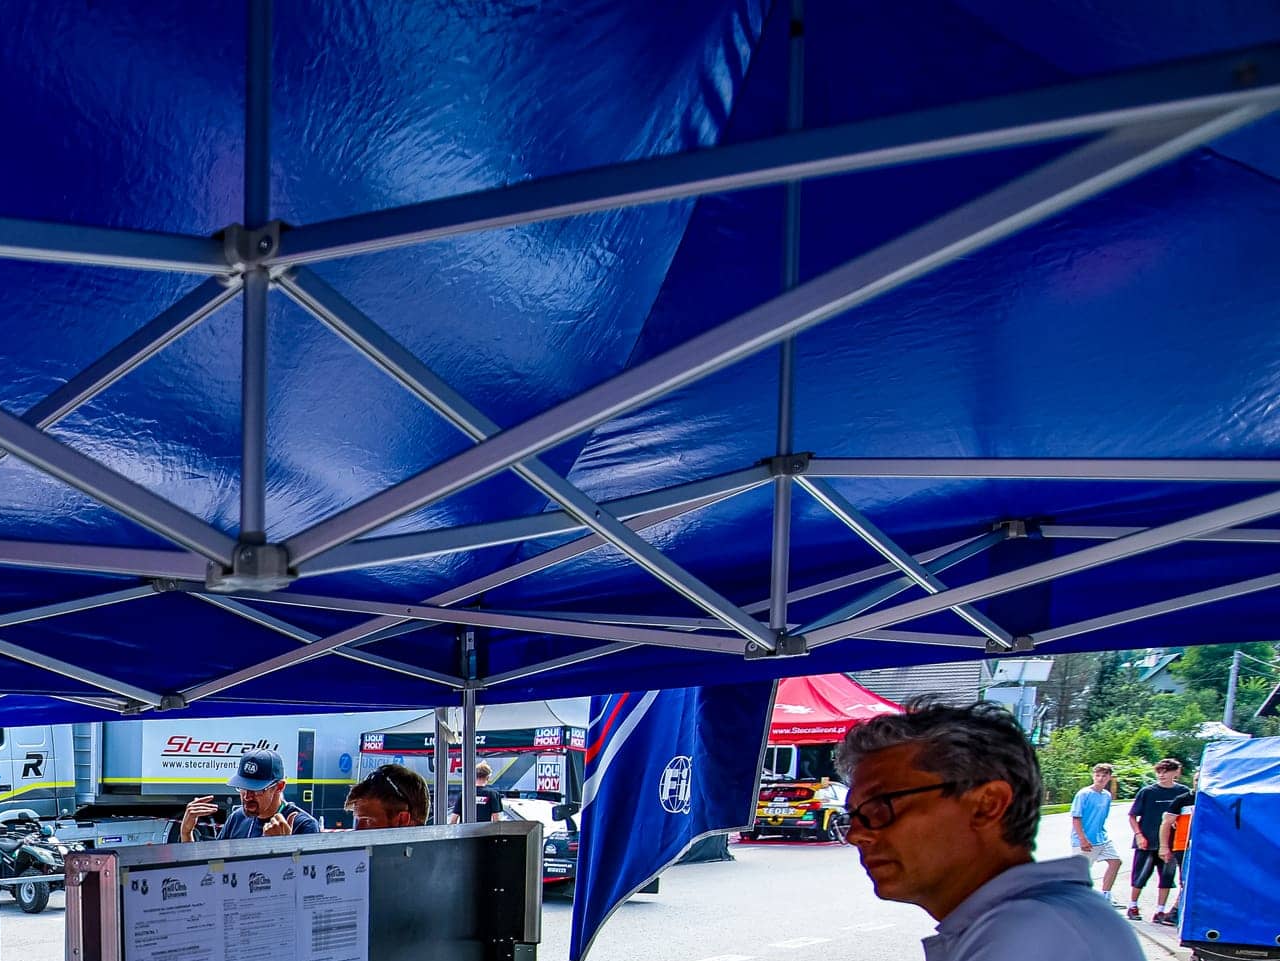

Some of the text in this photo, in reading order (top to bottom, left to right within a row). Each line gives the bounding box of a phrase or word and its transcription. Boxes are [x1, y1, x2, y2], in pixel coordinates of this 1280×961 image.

[536, 728, 560, 737] LIQUI
[364, 734, 384, 742] LIQUI
[535, 737, 560, 746] MOLY
[364, 742, 384, 750] MOLY
[22, 753, 43, 778] R
[538, 763, 560, 776] LIQUI
[538, 777, 560, 791] MOLY
